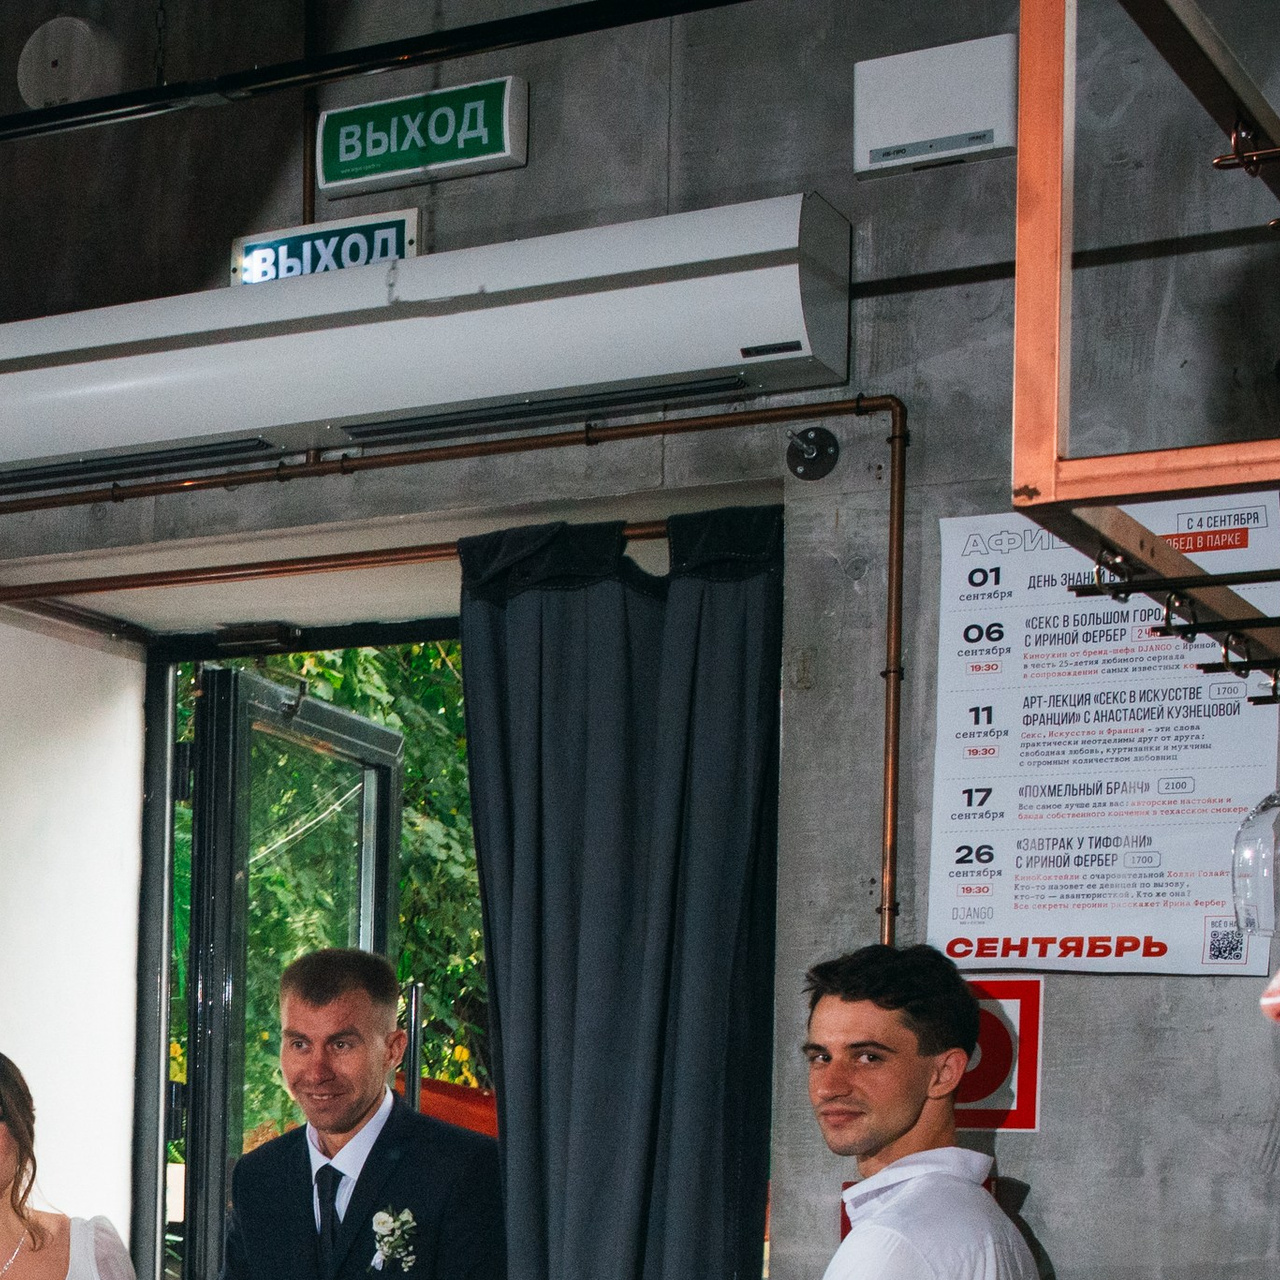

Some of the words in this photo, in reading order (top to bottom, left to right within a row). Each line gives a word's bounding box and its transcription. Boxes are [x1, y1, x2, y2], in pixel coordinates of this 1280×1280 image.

[339, 100, 488, 162] ВЫХОД
[252, 228, 399, 284] ВЫХОД
[1187, 518, 1194, 530] С
[1196, 517, 1203, 529] 4
[1207, 512, 1260, 528] СЕНТЯБРЯ
[1197, 536, 1203, 548] В
[1207, 533, 1241, 546] ПАРКЕ
[968, 567, 1001, 587] 01
[1028, 575, 1057, 590] ДЕНЬ
[959, 590, 1013, 602] сентября
[1025, 616, 1059, 630] «СЕКС
[1063, 615, 1070, 628] В
[1073, 610, 1129, 628] БОЛЬШОМ
[1133, 608, 1176, 623] ГОРО
[963, 623, 1004, 643] 06
[1025, 635, 1031, 647] С
[1035, 630, 1078, 647] ИРИНОЙ
[1082, 628, 1127, 644] ФЕРБЕР
[1137, 629, 1143, 639] 2
[957, 646, 1011, 658] сентября
[1023, 651, 1068, 661] Киноужин
[1138, 644, 1172, 652] DJANGO
[1183, 642, 1216, 651] Ириной
[970, 663, 999, 672] 19:30
[1059, 659, 1098, 668] 25-летия
[1101, 656, 1144, 665] любимого
[1147, 654, 1185, 662] сериала
[1031, 669, 1099, 679] сопровождении
[1101, 667, 1129, 675] самых
[1132, 664, 1180, 673] известных
[1023, 693, 1091, 709] АРТ-ЛЕКЦИЯ
[1094, 691, 1127, 705] «СЕКС
[1129, 690, 1136, 703] В
[1139, 686, 1202, 702] ИСКУССТВЕ
[1216, 686, 1239, 695] 1700
[969, 706, 992, 725] 11
[1022, 711, 1080, 726] ФРАНЦИИ»
[1084, 711, 1090, 723] С
[1093, 705, 1164, 723] АНАСТАСИЕЙ
[1167, 700, 1240, 719] КУЗНЕЦОВОЙ
[955, 729, 1009, 739] сентября
[1048, 730, 1096, 739] Искусство
[1106, 727, 1145, 736] Франция
[1020, 740, 1079, 749] практически
[1081, 737, 1135, 746] неотделимы
[1137, 735, 1159, 744] друг
[1174, 733, 1205, 743] друга:
[967, 748, 996, 757] 19:30
[1019, 749, 1066, 758] свободная
[1106, 745, 1161, 755] куртизанки
[1171, 743, 1212, 752] мужчины
[1027, 759, 1070, 769] огромным
[1072, 755, 1131, 765] количеством
[1133, 754, 1178, 763] любовниц
[1018, 780, 1103, 798] «ПОХМЕЛЬНЫЙ
[1106, 781, 1151, 795] БРАНЧ»
[1164, 781, 1187, 790] 2100
[962, 788, 992, 807] 17
[1018, 803, 1034, 811] Все
[1064, 801, 1090, 811] лучше
[1131, 799, 1178, 808] авторские
[1180, 796, 1224, 805] настойки
[950, 810, 1005, 821] сентября
[1018, 811, 1044, 820] блюда
[1046, 810, 1106, 819] собственного
[1108, 809, 1150, 818] копчения
[1160, 808, 1208, 816] техасском
[1210, 805, 1249, 814] смокере
[1016, 837, 1073, 852] «ЗАВТРАК
[1077, 836, 1085, 850] У
[1088, 835, 1153, 849] ТИФФАНИ»
[955, 845, 994, 864] 26
[1016, 856, 1022, 869] С
[1026, 853, 1070, 868] ИРИНОЙ
[1073, 853, 1118, 868] ФЕРБЕР
[1131, 856, 1153, 864] 1700
[948, 868, 1002, 879] сентября
[1090, 870, 1165, 880] очаровательной
[1167, 870, 1196, 878] Холли
[961, 886, 990, 894] 19:30
[1014, 883, 1047, 891] Кто-то
[1099, 881, 1138, 890] девицей
[1140, 881, 1151, 889] по
[1136, 889, 1153, 898] Кто
[1155, 890, 1167, 898] же
[1169, 889, 1192, 898] она?
[1031, 902, 1069, 911] секреты
[1072, 901, 1109, 911] героини
[1111, 900, 1160, 910] расскажет
[1162, 899, 1191, 909] Ирина
[1193, 899, 1227, 908] Фербер
[952, 907, 994, 920] DJANGO
[945, 935, 1168, 959] СЕНТЯБРЬ
